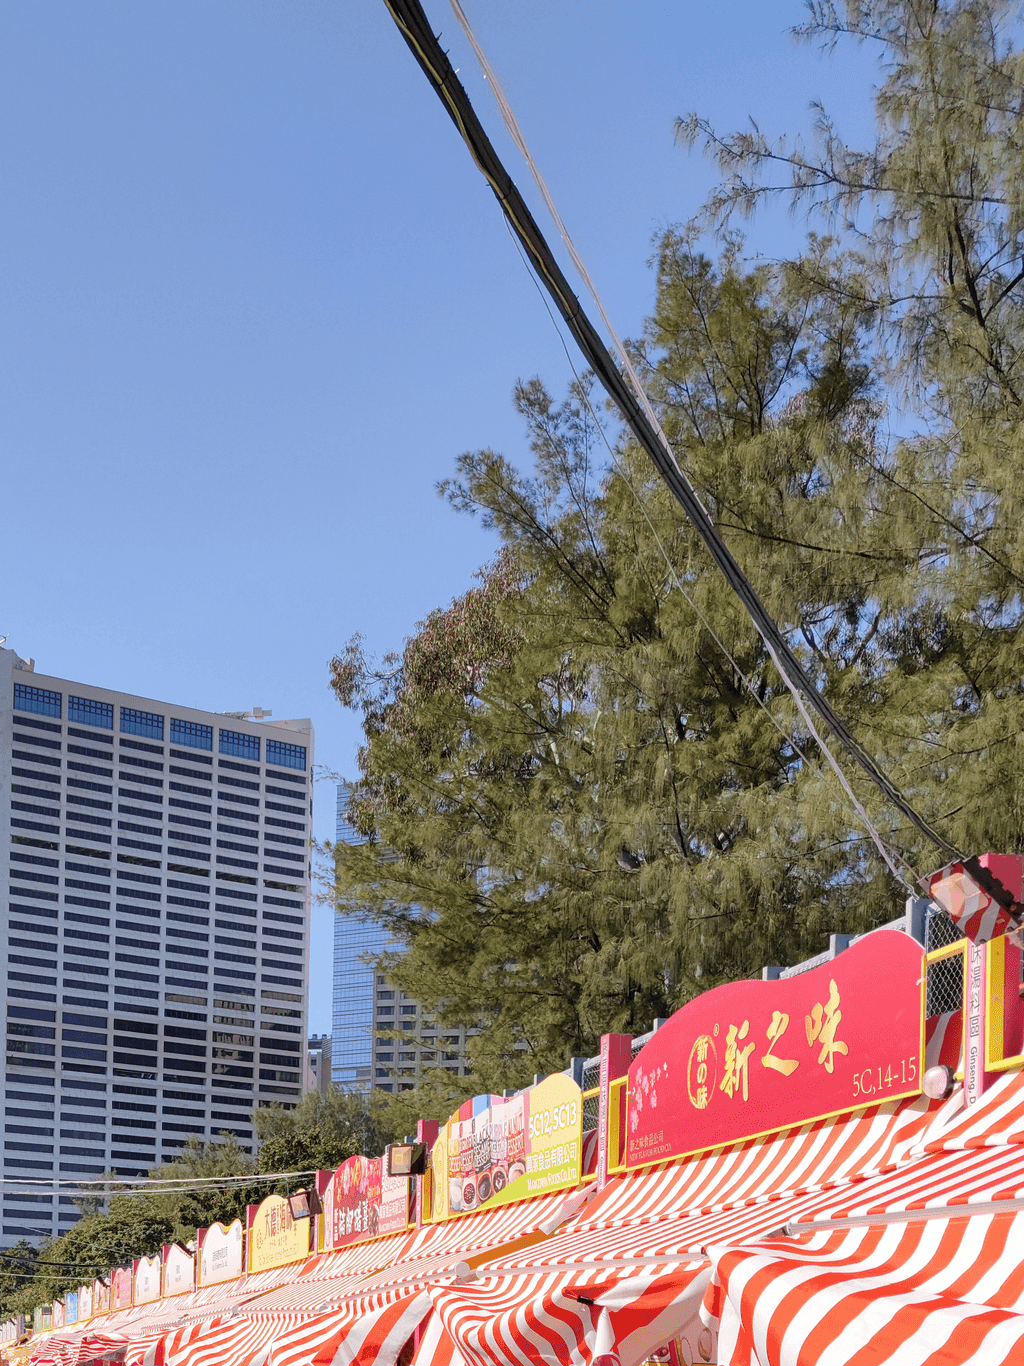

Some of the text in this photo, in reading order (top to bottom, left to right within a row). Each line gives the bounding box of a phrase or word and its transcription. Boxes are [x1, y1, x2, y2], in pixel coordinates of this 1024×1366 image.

[719, 978, 850, 1102] 新之味
[696, 1036, 709, 1110] 新の味
[852, 1056, 917, 1097] 5C,14-15
[968, 1046, 978, 1094] Ginseng,
[529, 1100, 577, 1138] 5C12,5C13
